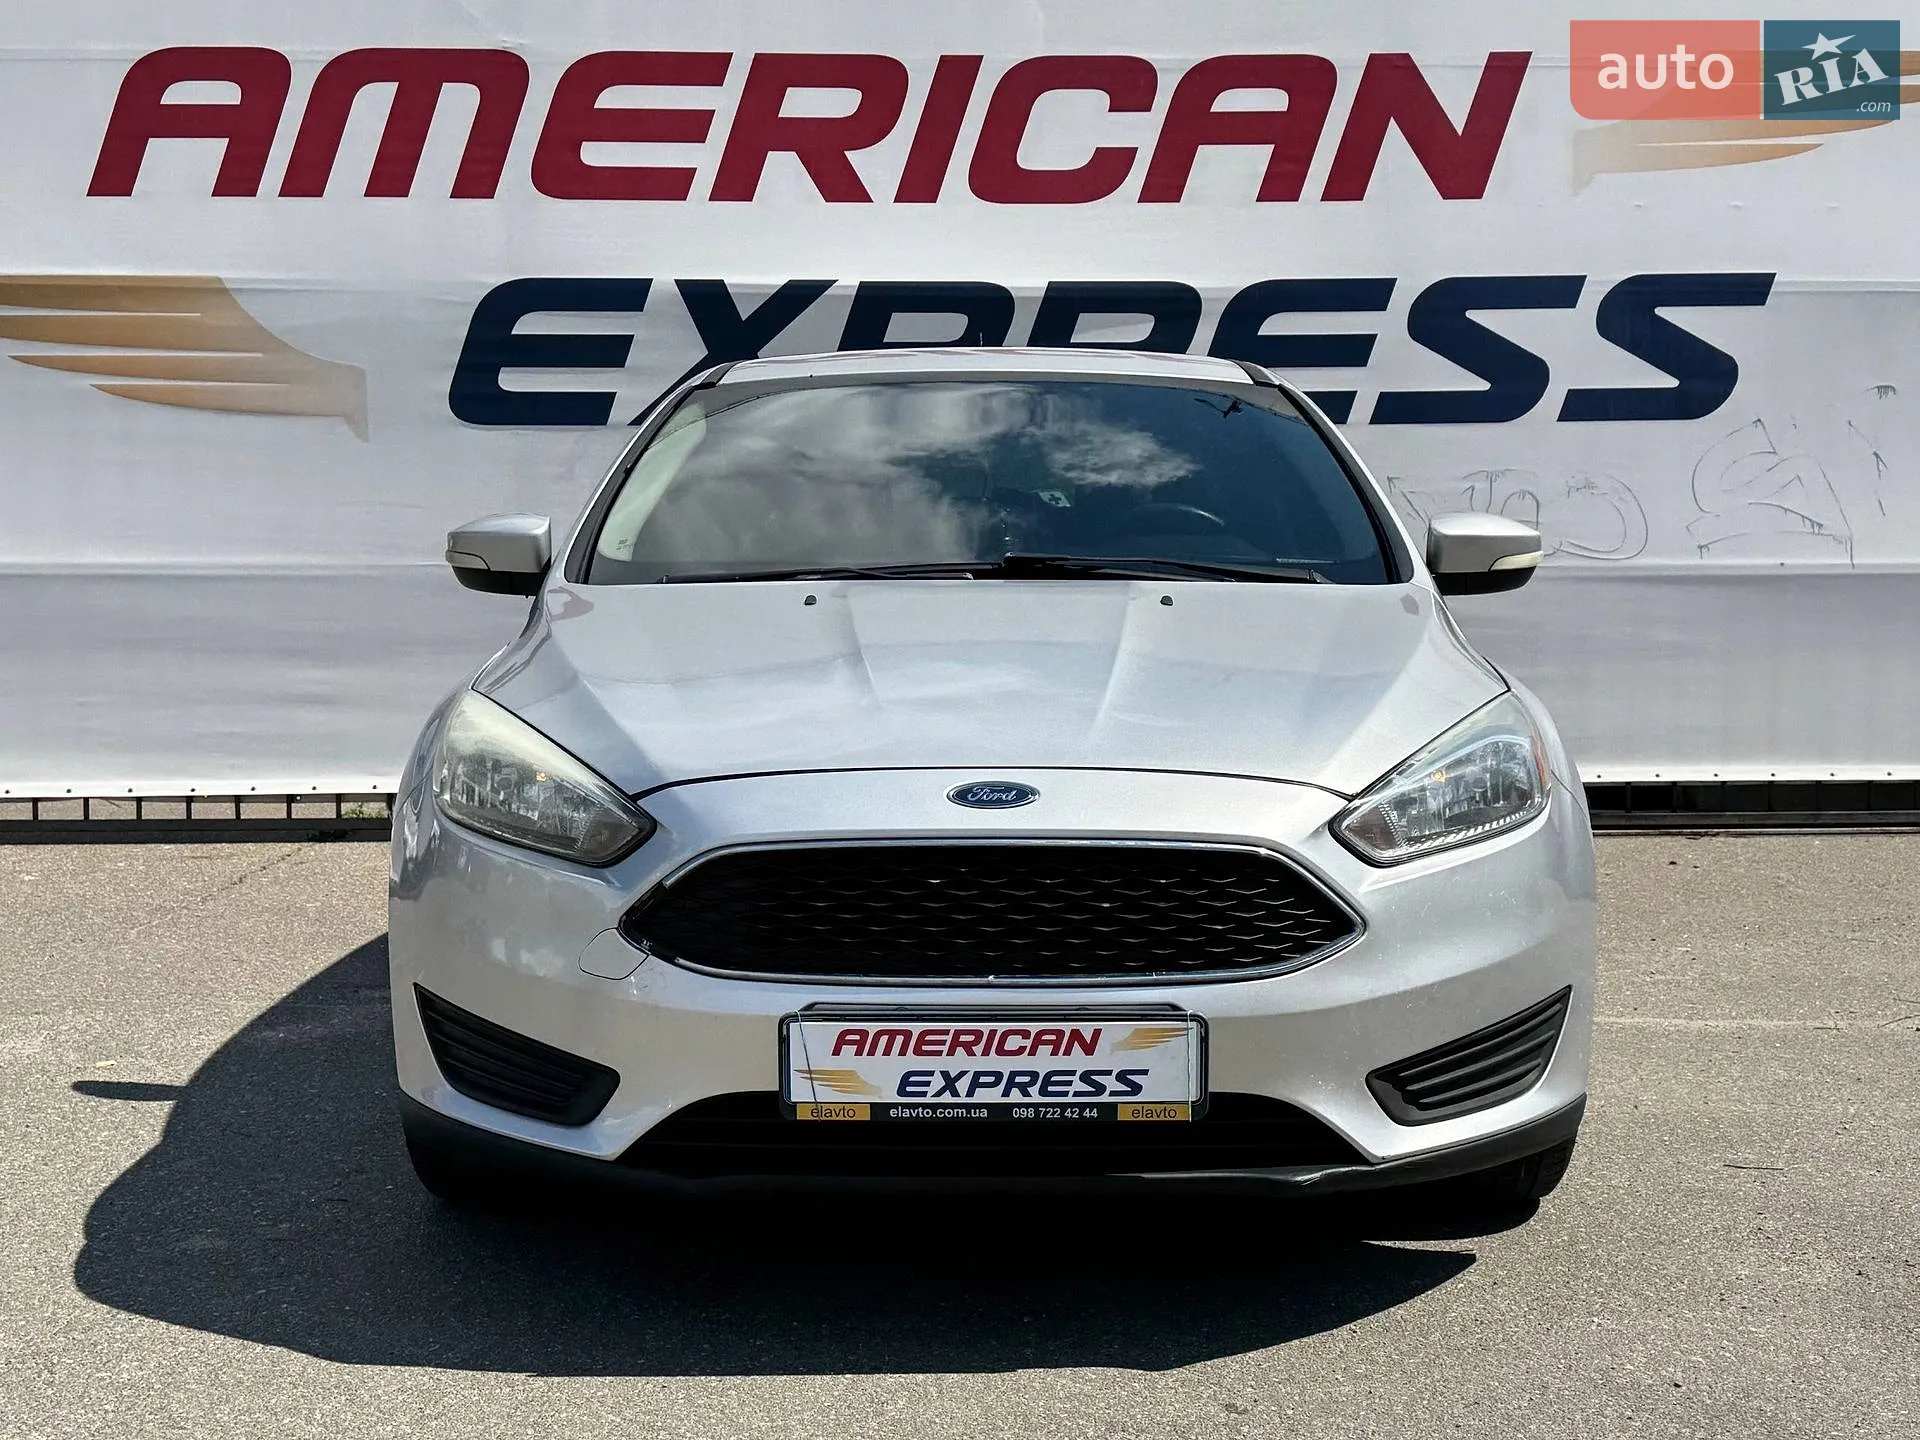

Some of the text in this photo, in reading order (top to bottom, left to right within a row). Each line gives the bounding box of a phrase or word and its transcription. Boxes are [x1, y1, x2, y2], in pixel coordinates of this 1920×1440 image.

[88, 47, 1530, 202] AMERICAN
[967, 786, 1017, 801] Ford
[831, 1029, 1102, 1057] AMERICAN
[896, 1068, 1150, 1098] EXPRESS
[810, 1106, 856, 1119] elavto
[889, 1107, 988, 1118] elavto.com.ua
[1012, 1107, 1098, 1119] 098 722 42 44
[1131, 1106, 1177, 1119] elavto
